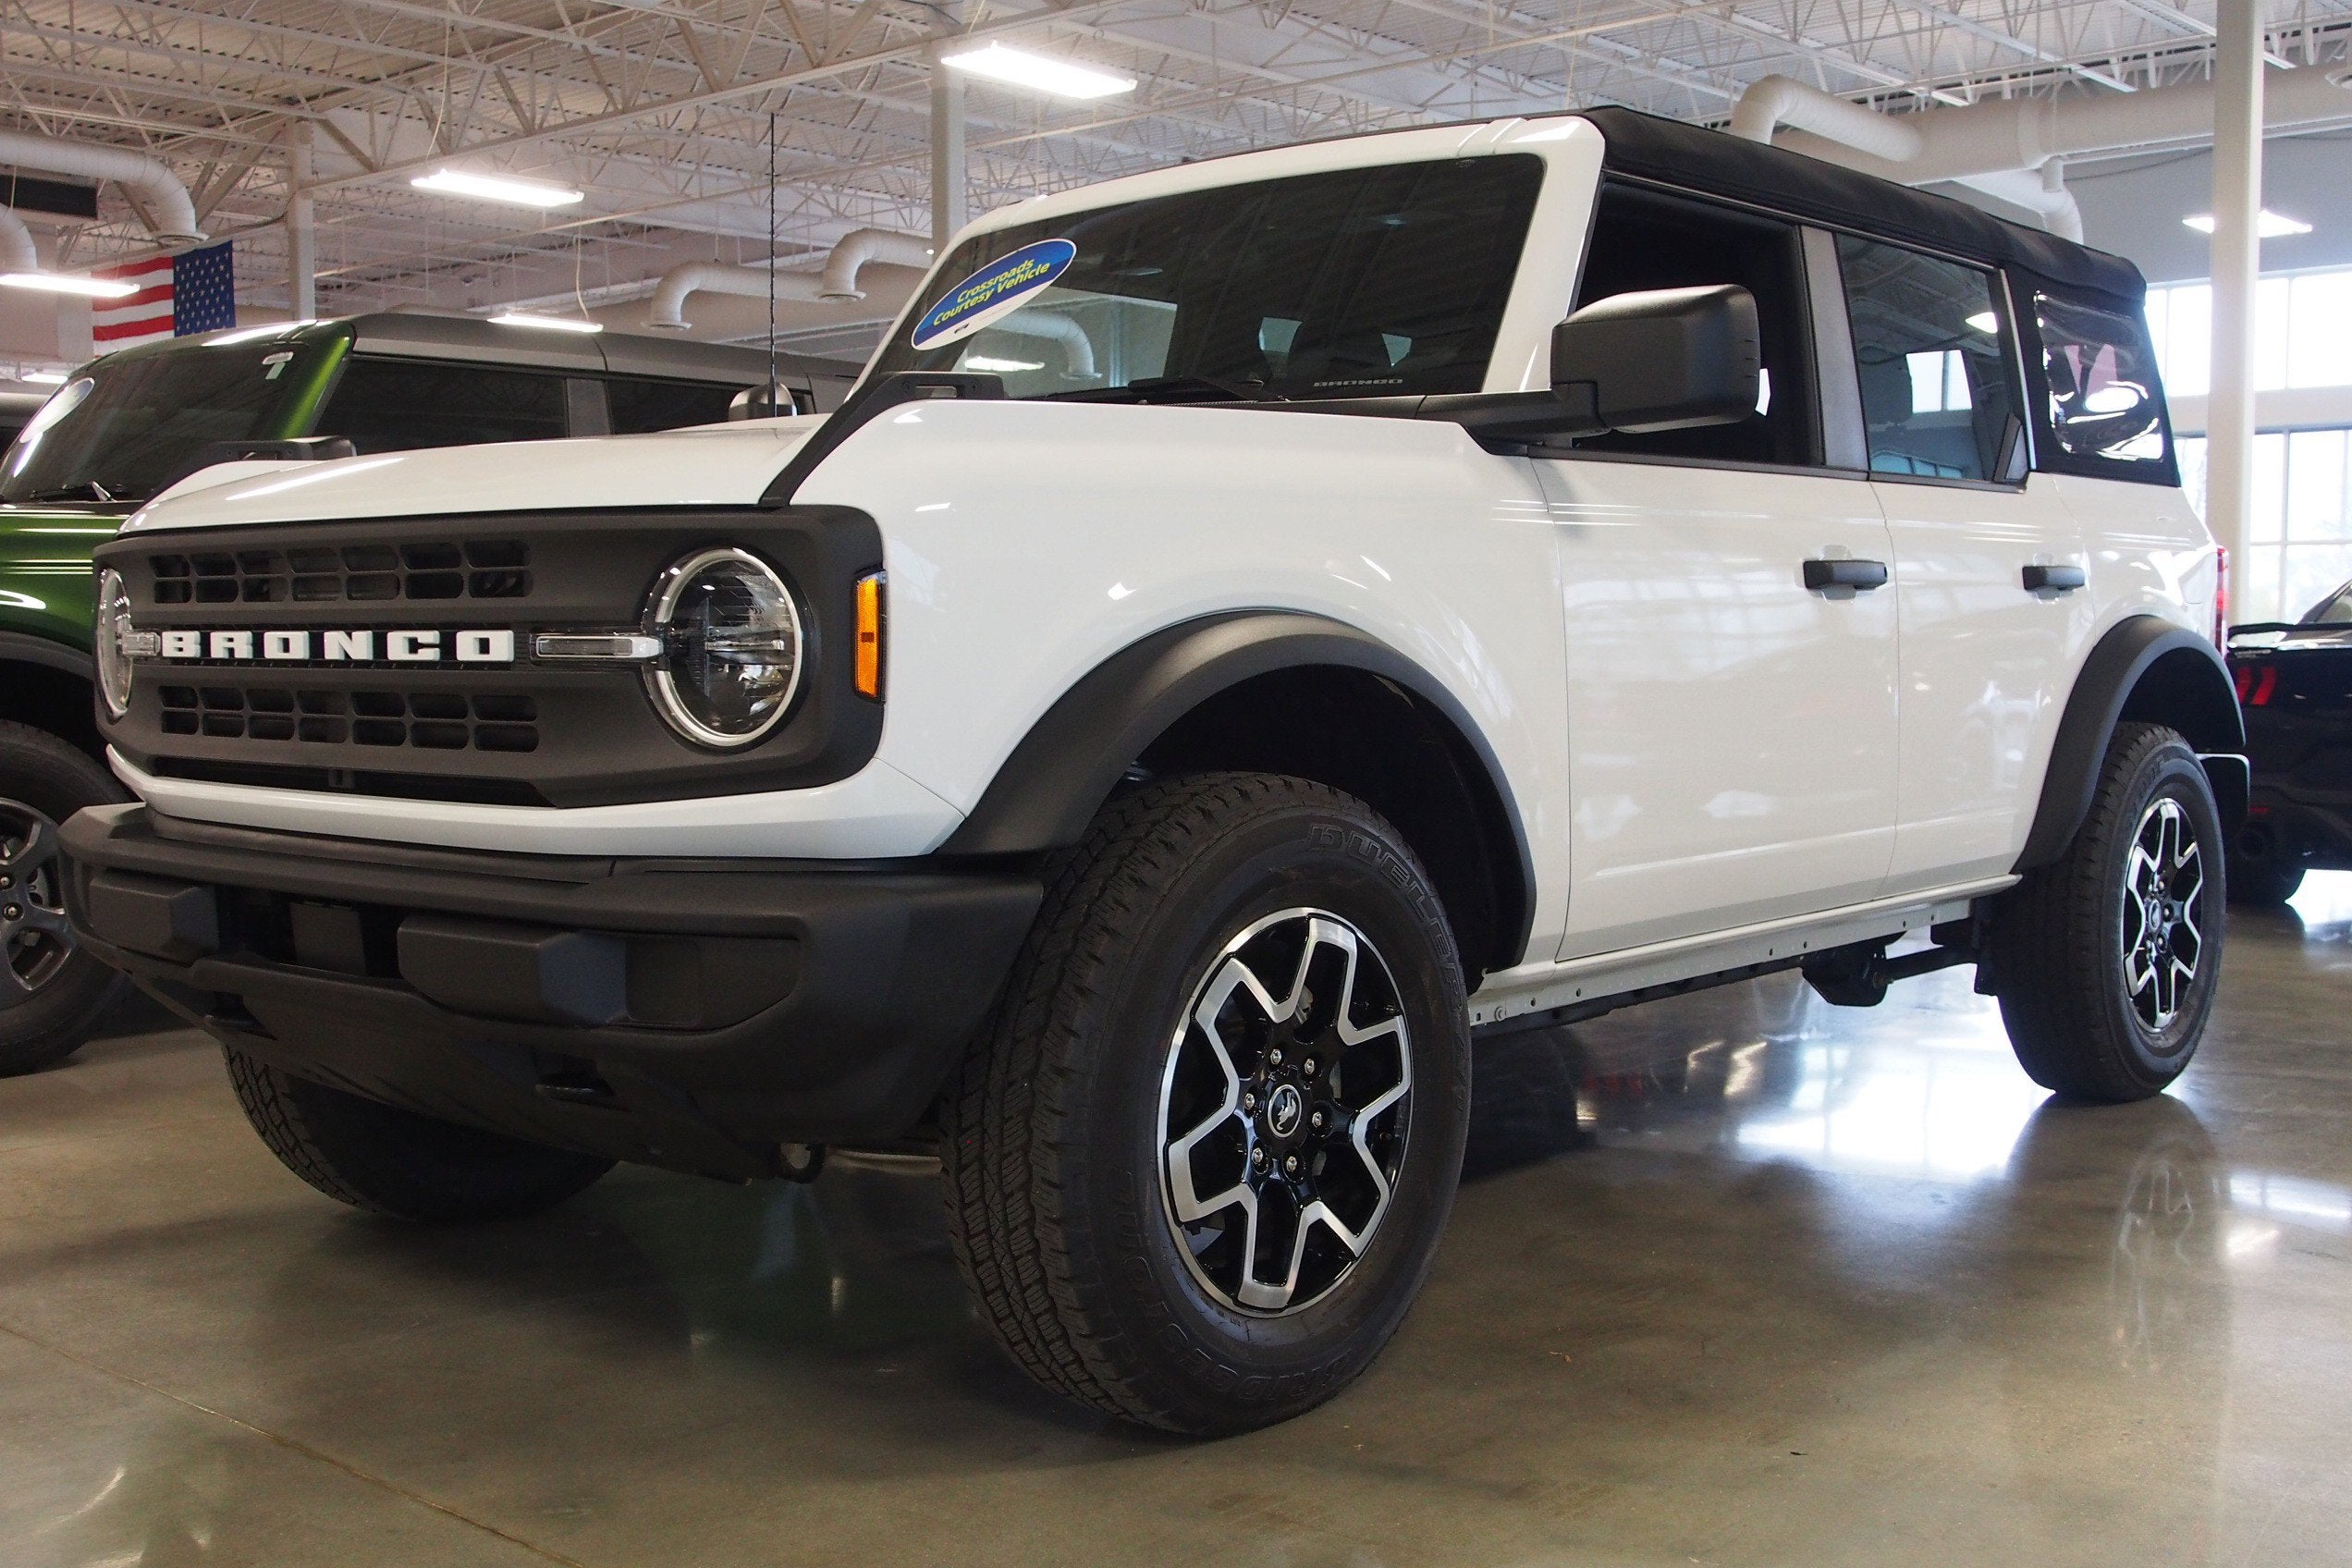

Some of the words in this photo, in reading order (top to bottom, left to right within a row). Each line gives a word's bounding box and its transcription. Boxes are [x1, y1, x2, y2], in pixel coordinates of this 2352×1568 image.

[934, 288, 994, 325] Courtesy
[997, 263, 1050, 294] Vehicle
[957, 258, 1035, 303] Crossroads
[161, 630, 515, 662] BRONCO
[1308, 822, 1464, 1013] DUELER
